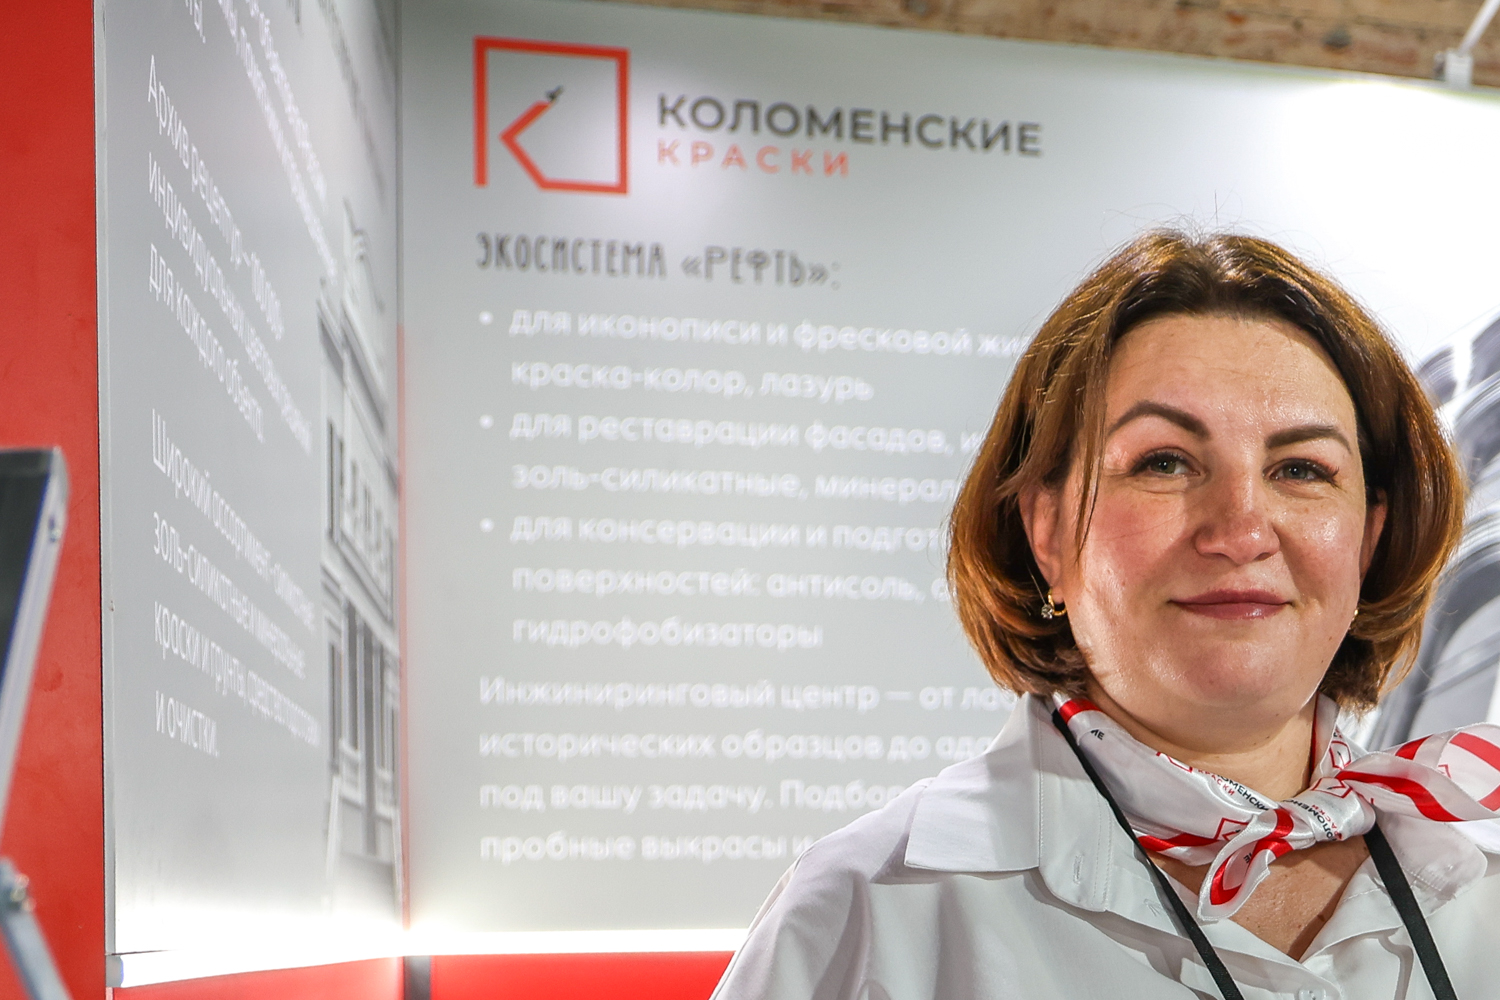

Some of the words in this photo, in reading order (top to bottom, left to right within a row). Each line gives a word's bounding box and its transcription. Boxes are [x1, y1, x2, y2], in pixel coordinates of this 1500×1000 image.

[658, 94, 1042, 156] КОЛОМЕНСКИЕ
[658, 140, 850, 177] КРАСКИ
[475, 231, 667, 278] ЭКОСИСТЕМА
[509, 309, 571, 336] для
[578, 313, 760, 346] иконописи
[767, 323, 788, 346] и
[793, 321, 972, 356] фресковой
[511, 361, 754, 399] краска-колор,
[759, 371, 874, 404] лазурь
[509, 411, 572, 440] для
[578, 414, 799, 449] реставрации
[804, 420, 953, 456] фасадов,
[512, 463, 808, 500] золь-силикатные,
[509, 515, 572, 543] для
[579, 518, 800, 549] консервации
[806, 527, 827, 547] и
[766, 573, 925, 603] антисоль,
[512, 616, 823, 651] гидрофобизаторы
[480, 675, 775, 710] Инжиниринговый
[781, 684, 880, 713] центр
[918, 685, 954, 711] от
[480, 731, 716, 761] исторических
[722, 731, 881, 762] образцов
[885, 737, 931, 762] до
[480, 784, 545, 811] под
[551, 784, 641, 815] вашу
[649, 784, 773, 814] задачу.
[480, 831, 636, 865] пробные
[642, 834, 787, 862] выкрасы
